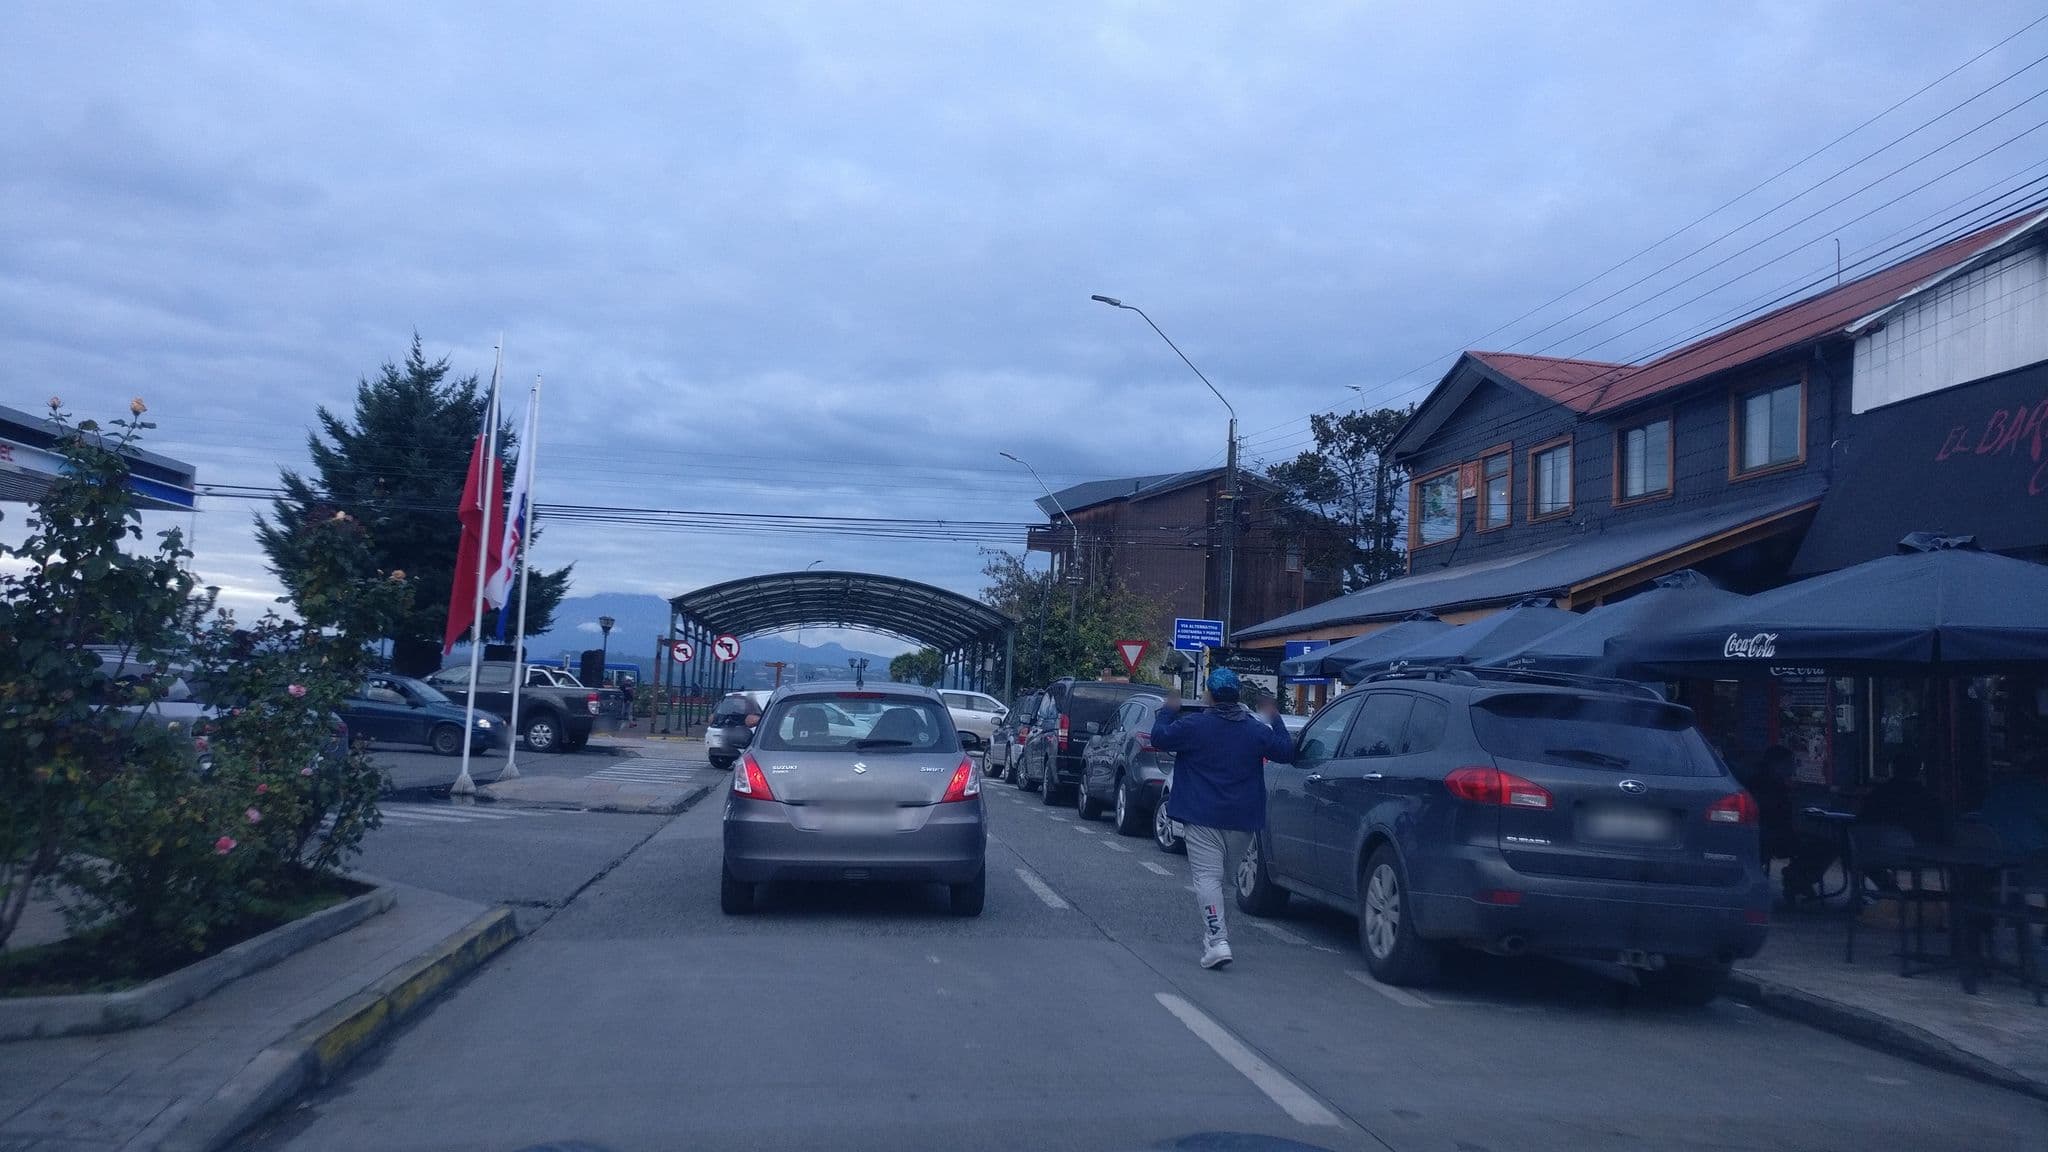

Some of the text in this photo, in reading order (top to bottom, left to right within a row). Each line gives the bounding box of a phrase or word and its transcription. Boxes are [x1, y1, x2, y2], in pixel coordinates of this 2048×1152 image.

[1935, 426, 1969, 461] EL
[1724, 632, 1779, 658] Coca-Cola
[1205, 904, 1221, 936] FILA
